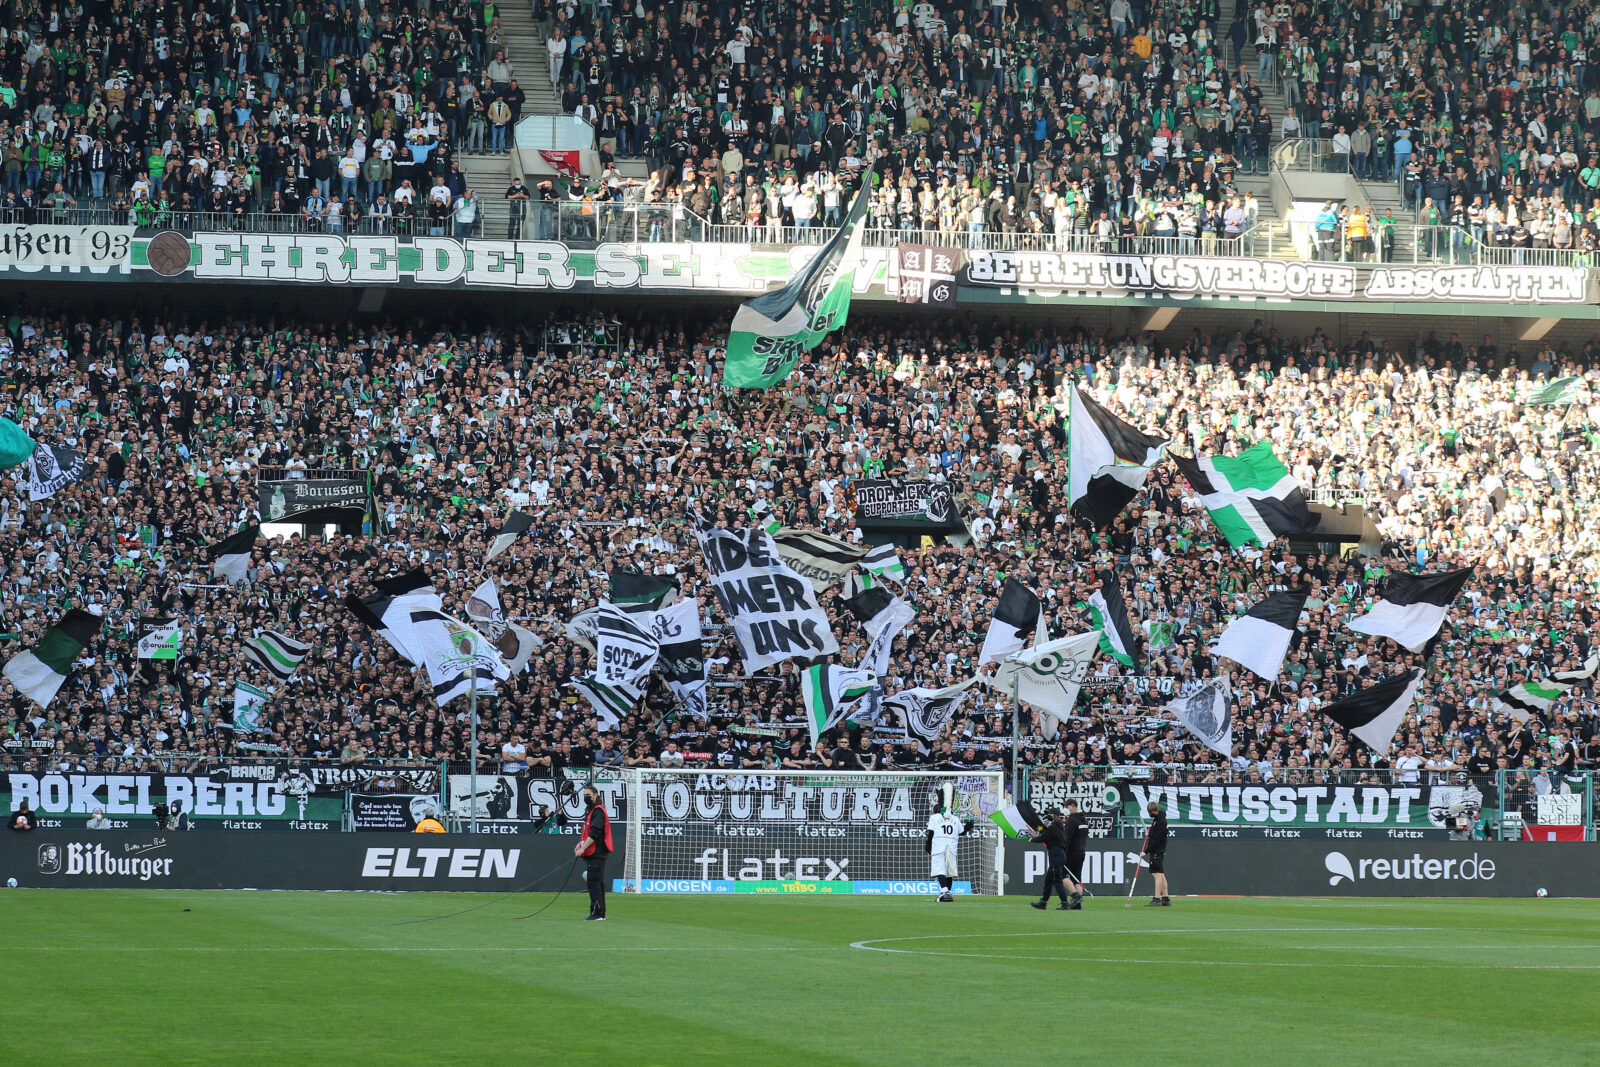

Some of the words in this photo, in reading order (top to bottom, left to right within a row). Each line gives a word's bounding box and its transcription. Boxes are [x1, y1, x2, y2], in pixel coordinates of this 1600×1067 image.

[194, 233, 399, 283] EHRE
[414, 237, 575, 288] DER
[968, 249, 1356, 297] BETRETUNGSVERBOTE
[1365, 265, 1586, 301] ABSCHAFFEN
[294, 483, 364, 499] Borussen
[857, 484, 927, 505] DROPKICK
[864, 500, 920, 517] SUPPORTERS
[749, 617, 826, 656] UNS
[231, 765, 276, 778] BANDA
[1029, 781, 1106, 798] BEGLEIT
[1129, 784, 1422, 823] VITUSSTADT
[1541, 795, 1578, 804] YANN
[1551, 804, 1571, 814] IST
[222, 820, 262, 829] flatex
[1540, 814, 1581, 824] SUPER
[289, 821, 329, 830] flatex
[641, 825, 683, 836] latex
[714, 825, 765, 836] flatex
[796, 826, 847, 837] flatex
[941, 824, 953, 835] 10
[877, 826, 928, 838] flatex
[1201, 828, 1239, 837] flatex
[1263, 829, 1301, 838] flatex
[1325, 829, 1363, 838] flatex
[1387, 830, 1424, 839] flatex
[64, 842, 174, 881] Bitburger
[361, 847, 521, 878] ELTEN
[694, 848, 850, 881] flatex
[1024, 851, 1125, 884] PMA
[1359, 852, 1496, 880] reuter.de
[646, 880, 712, 892] JONGEN
[885, 882, 940, 895] JONGE
